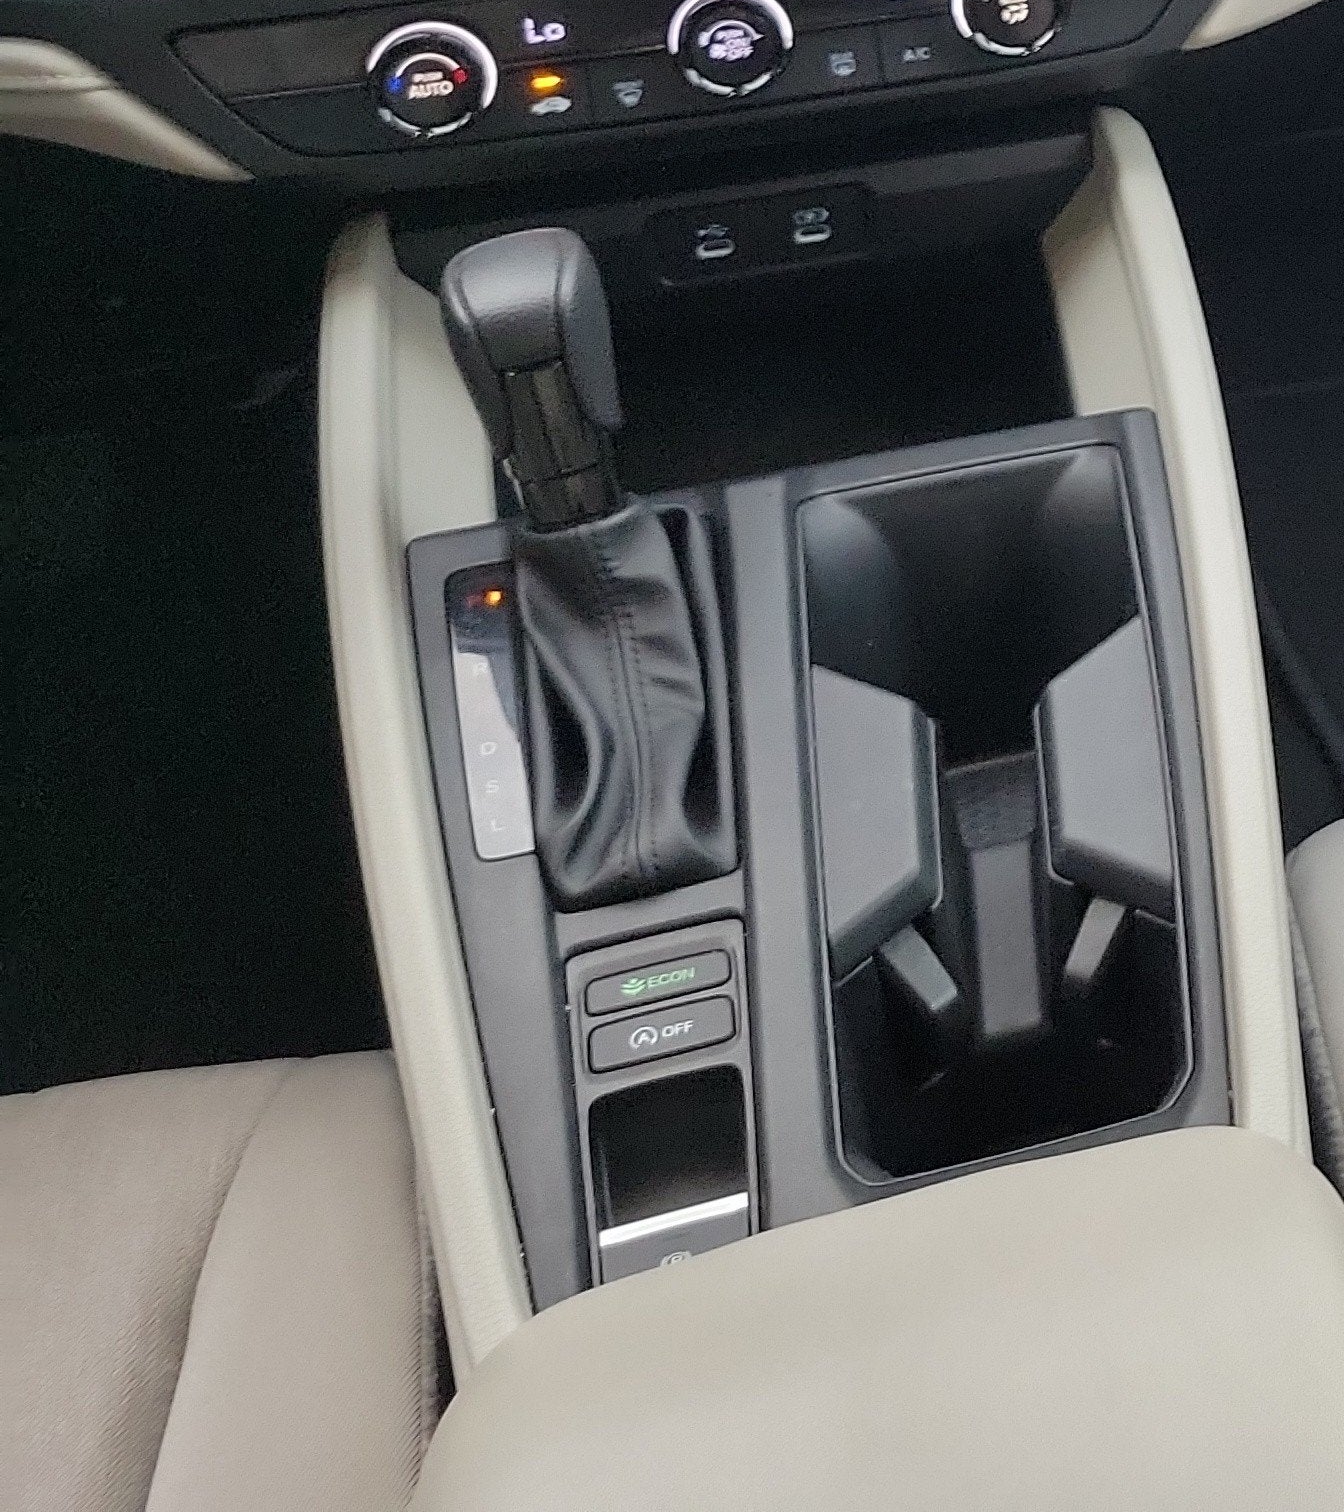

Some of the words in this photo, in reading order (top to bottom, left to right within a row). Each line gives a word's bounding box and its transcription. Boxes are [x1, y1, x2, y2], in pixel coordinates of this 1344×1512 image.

[408, 80, 454, 100] AUTO
[473, 660, 488, 674] R
[480, 741, 498, 756] D
[485, 779, 500, 793] S
[490, 817, 503, 831] L
[647, 967, 696, 989] ECON
[661, 1019, 694, 1037] OFF
